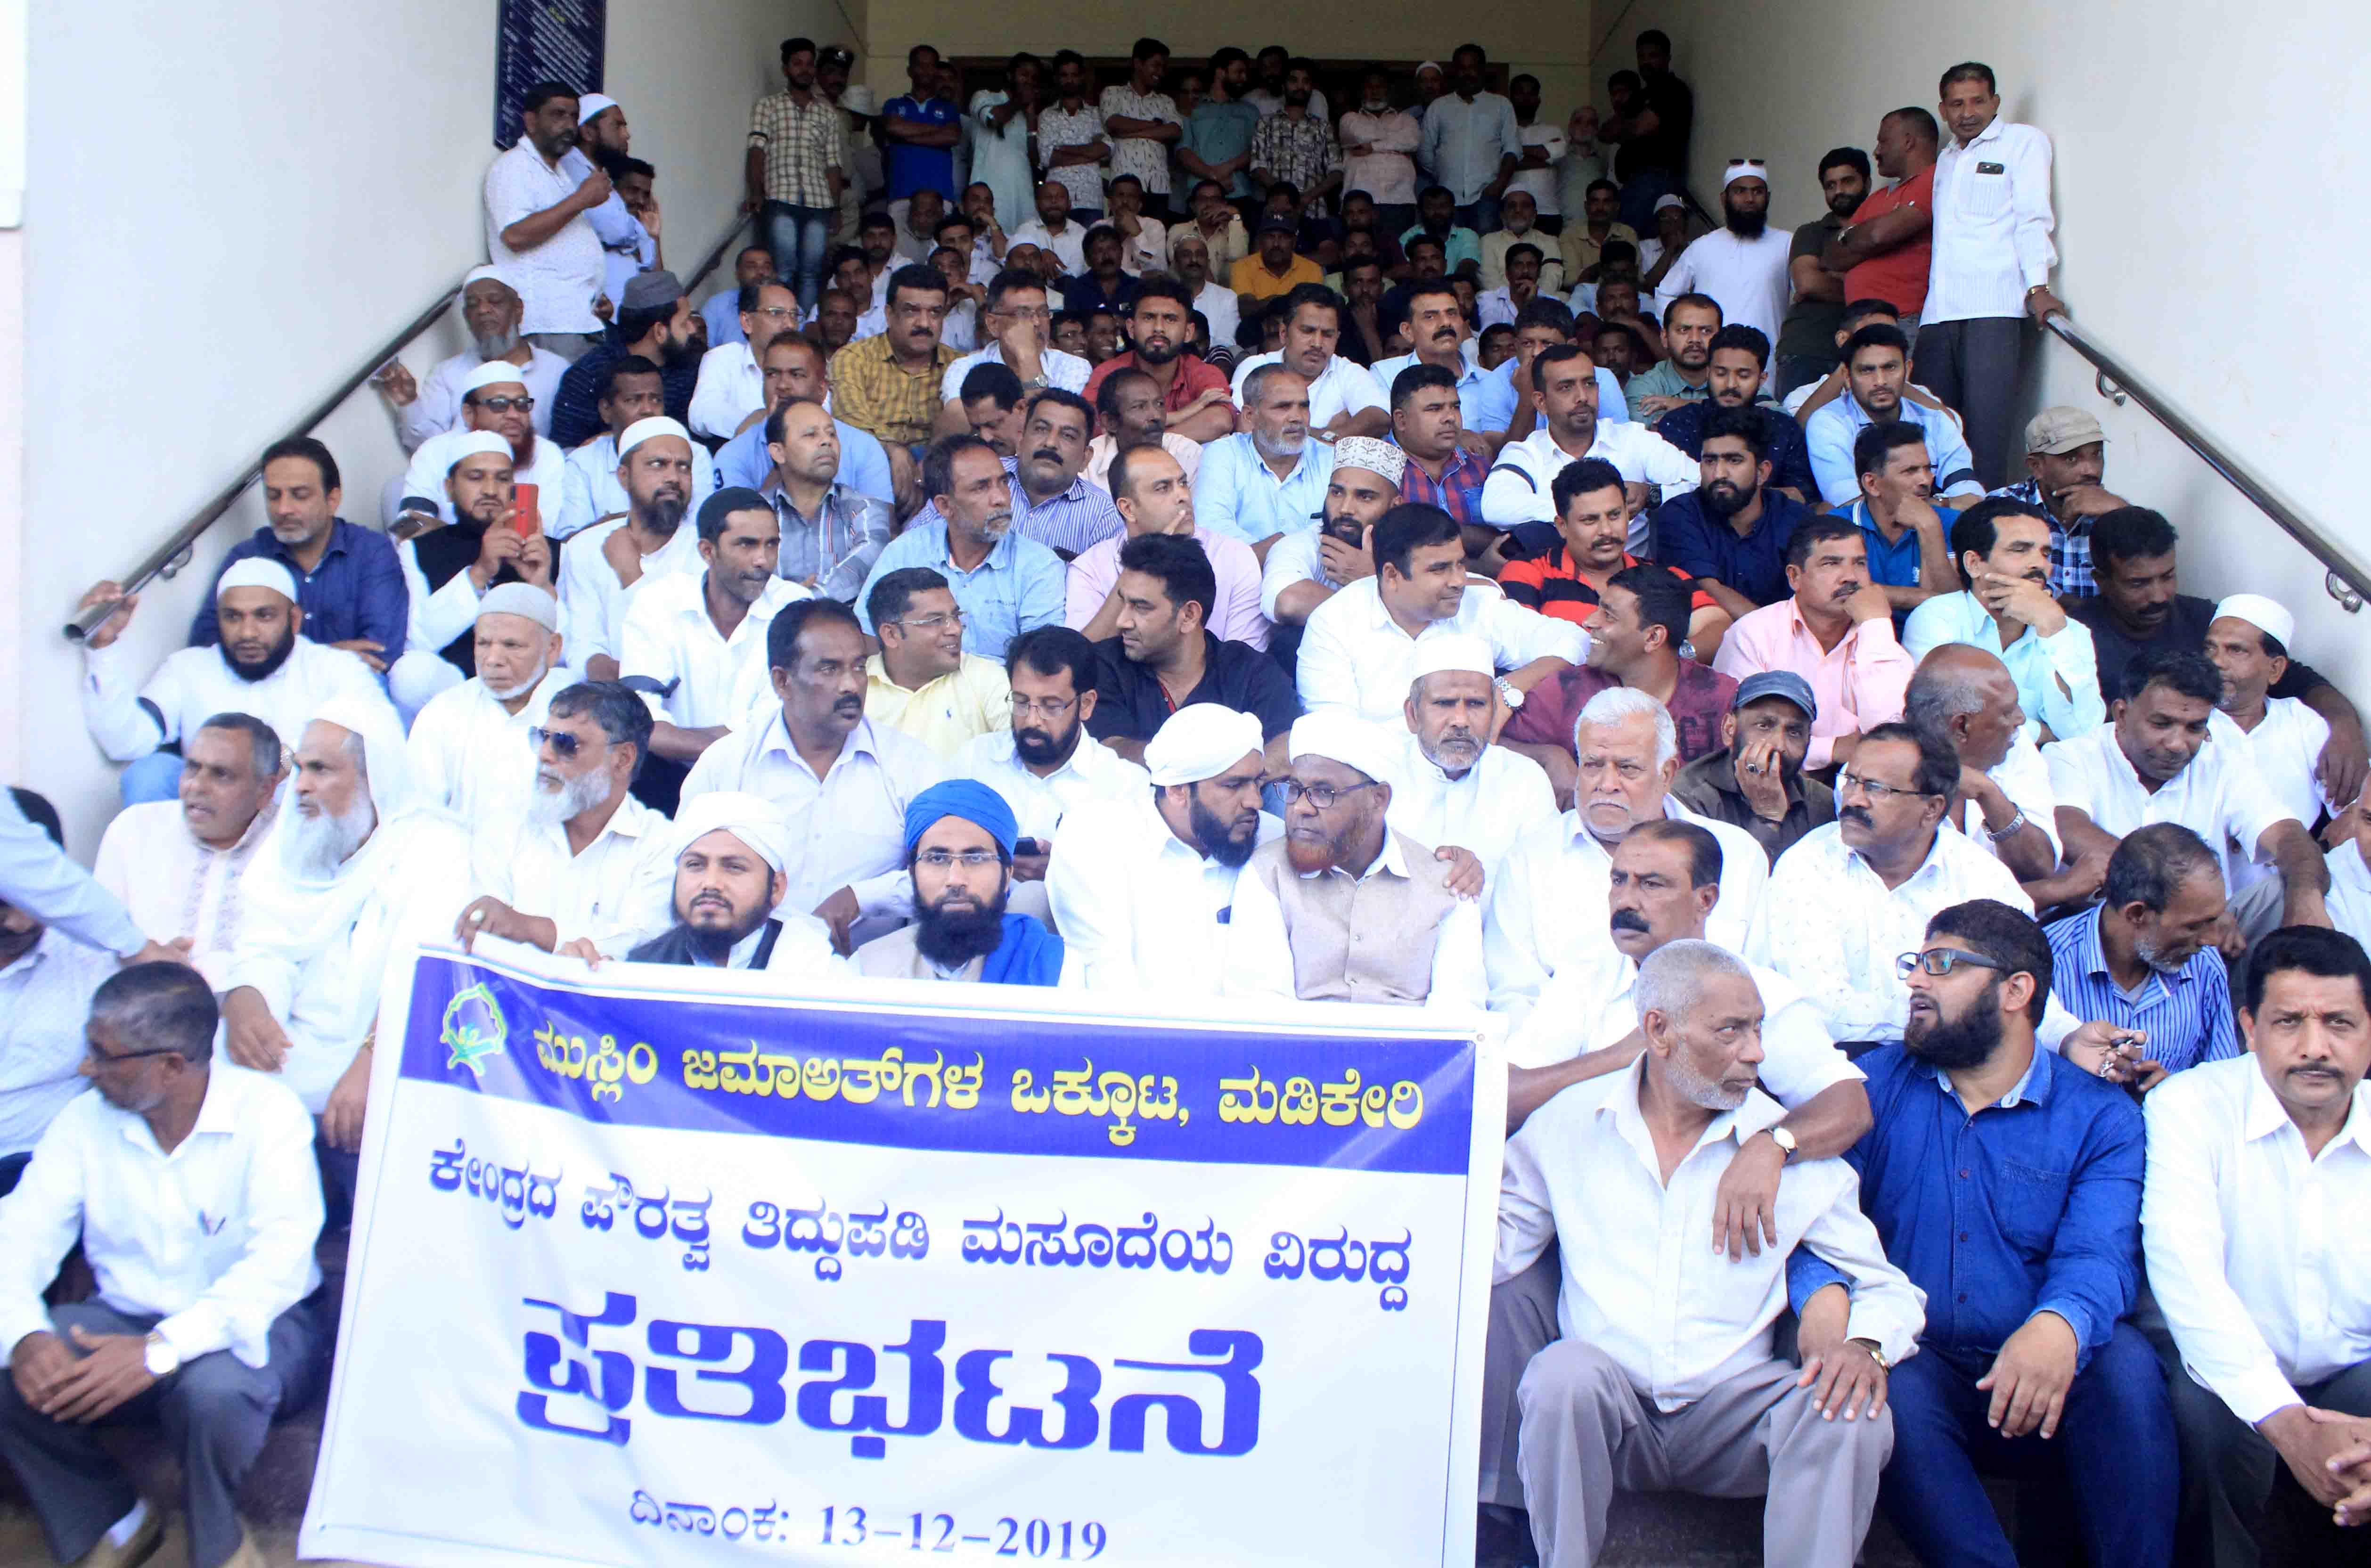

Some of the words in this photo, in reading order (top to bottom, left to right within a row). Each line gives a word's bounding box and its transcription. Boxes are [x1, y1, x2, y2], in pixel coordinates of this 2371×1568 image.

[533, 1020, 658, 1102] ಮುಸ್ಲಿಂ
[1011, 1056, 1190, 1146] ಒಕ್ಕೂಟ,
[1219, 1064, 1423, 1129] ಮಡಿಕೇರಿ
[430, 1138, 562, 1230] ಕೇಂದ್ರದ
[580, 1172, 713, 1272] ಪೌರತ್ವ
[741, 1197, 930, 1282] ತಿದ್ದುಪಡಿ
[961, 1205, 1233, 1275] ಮಸೂದೆಯ
[515, 1290, 1264, 1461] ಪ್ರತಿಭಟನೆ
[630, 1489, 789, 1542] ದಿನಾಂಕ:
[820, 1506, 1107, 1560] 13-12-2019
